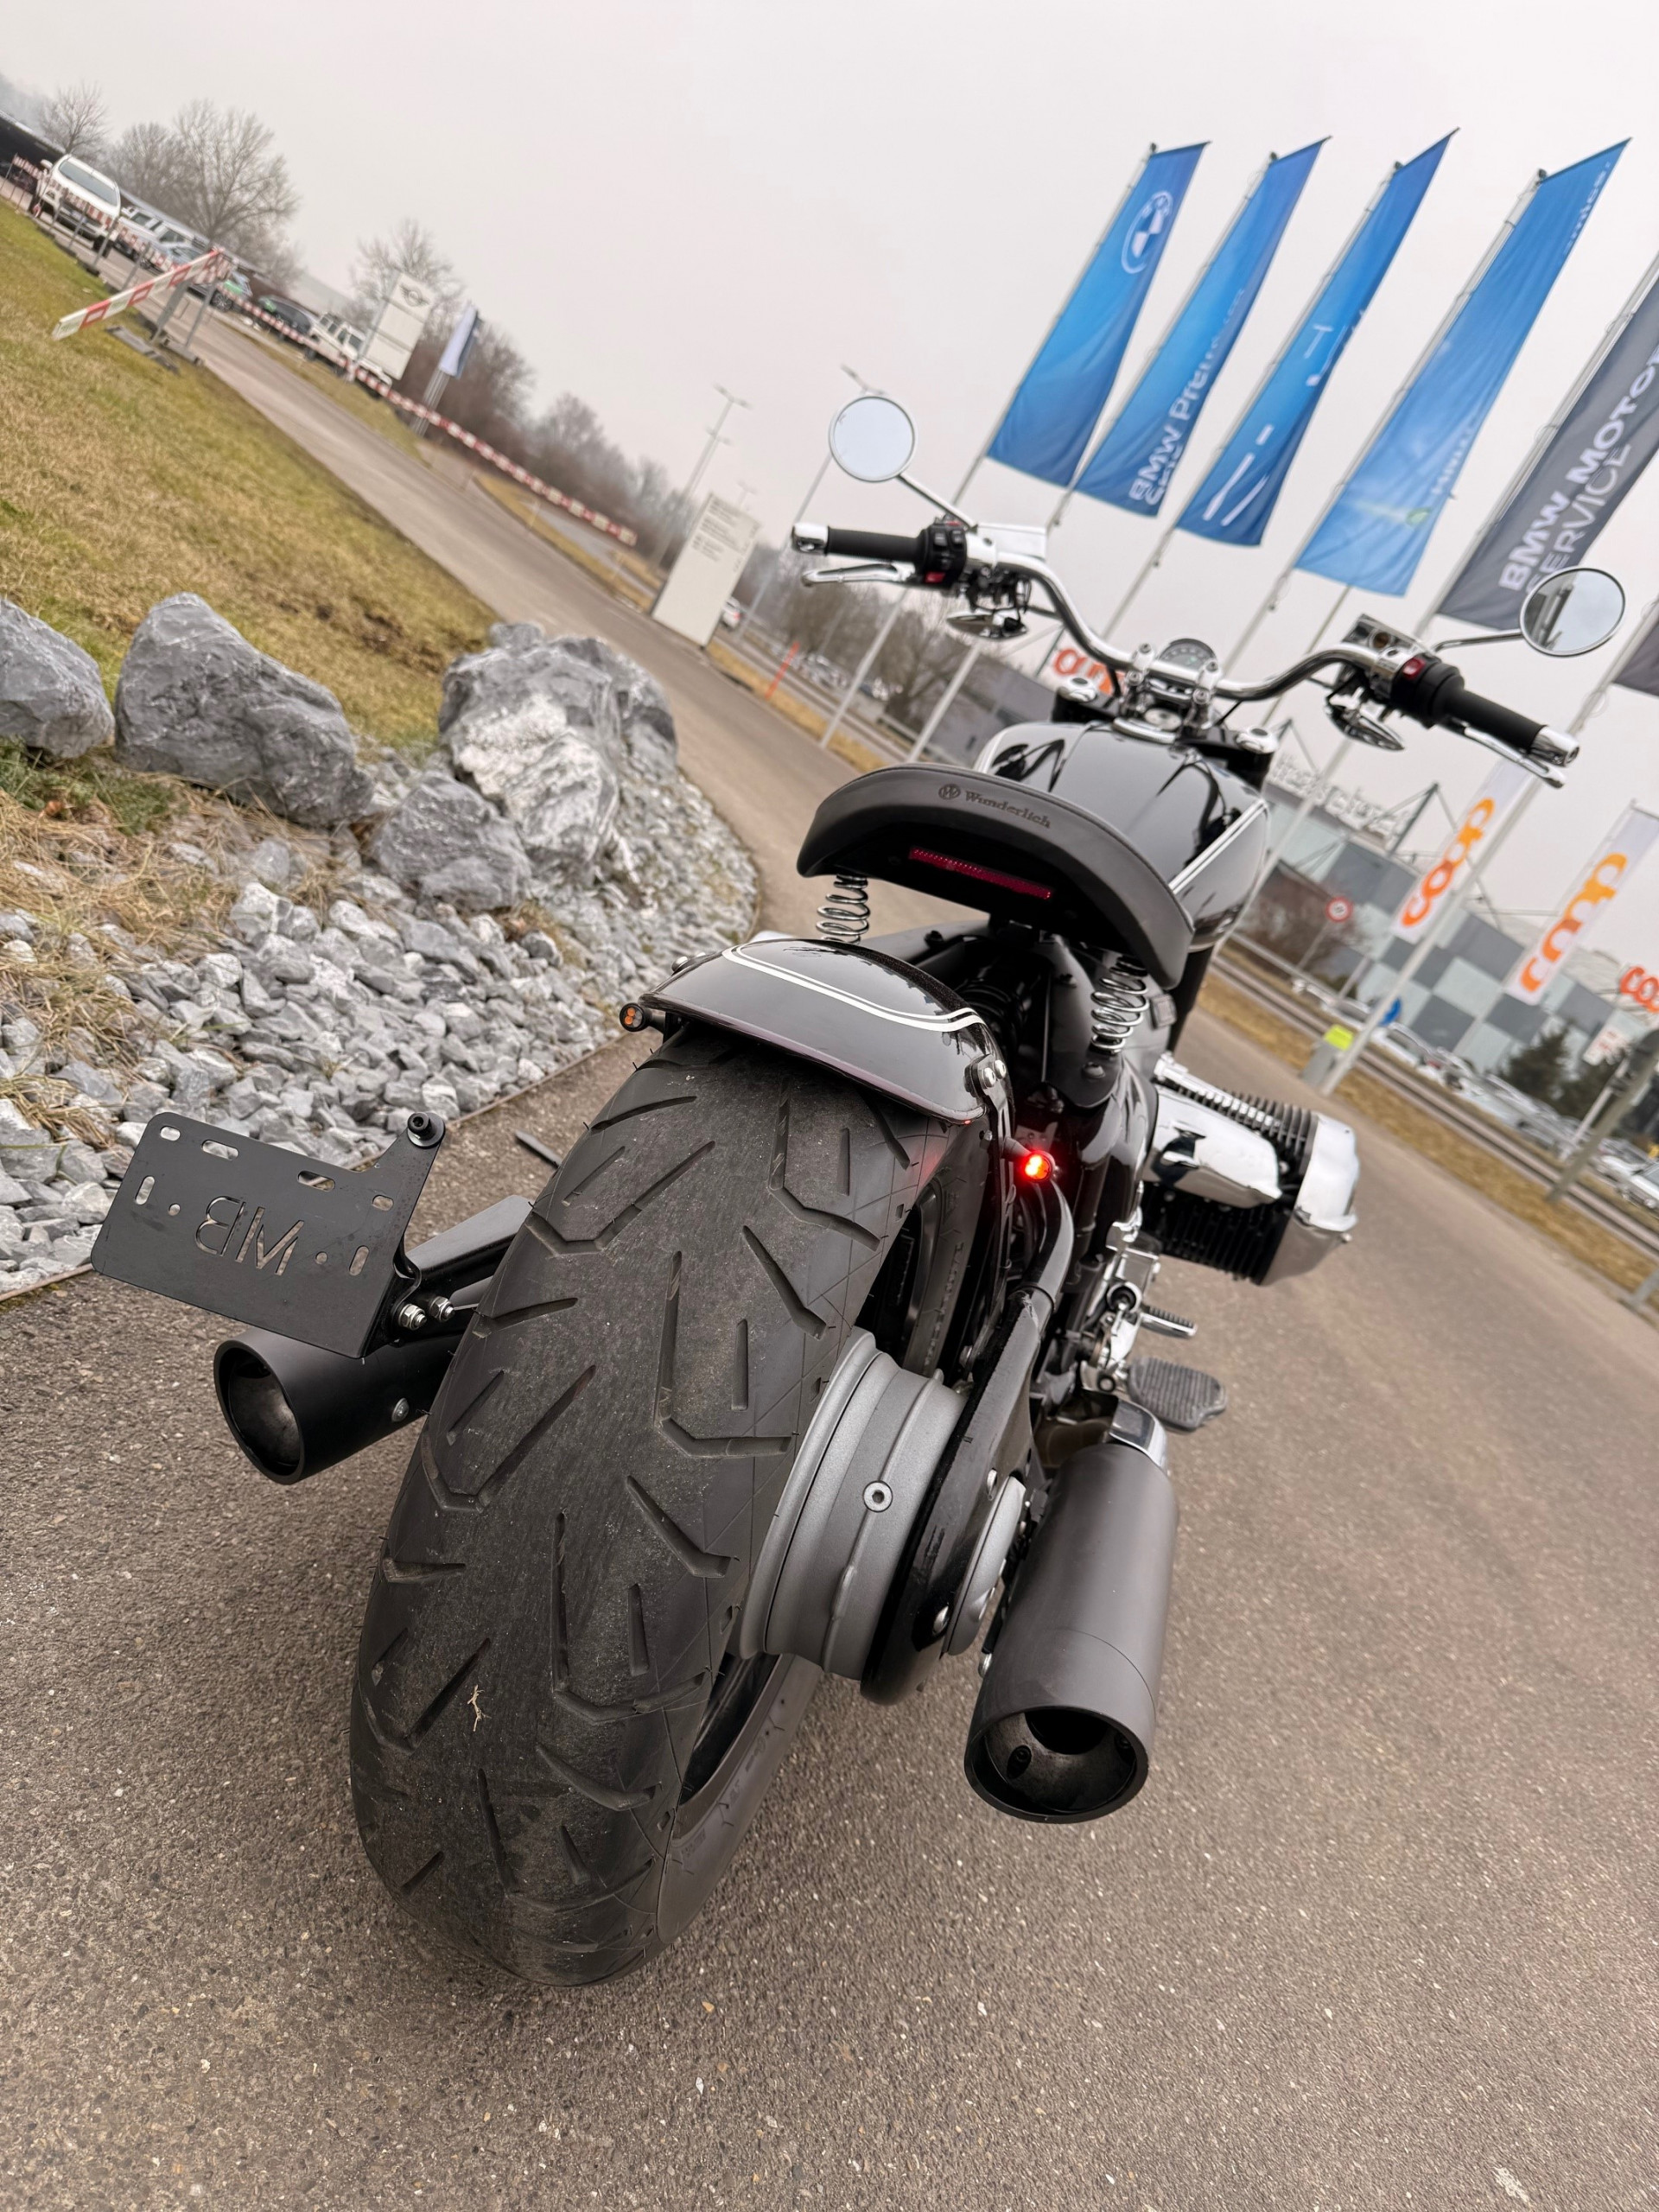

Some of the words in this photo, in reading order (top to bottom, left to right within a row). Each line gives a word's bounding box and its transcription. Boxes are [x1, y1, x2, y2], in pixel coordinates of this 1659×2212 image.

[1128, 424, 1182, 500] BMW
[1498, 491, 1570, 591] BMW
[965, 790, 1052, 829] Wunderlich
[1401, 798, 1495, 926] coop
